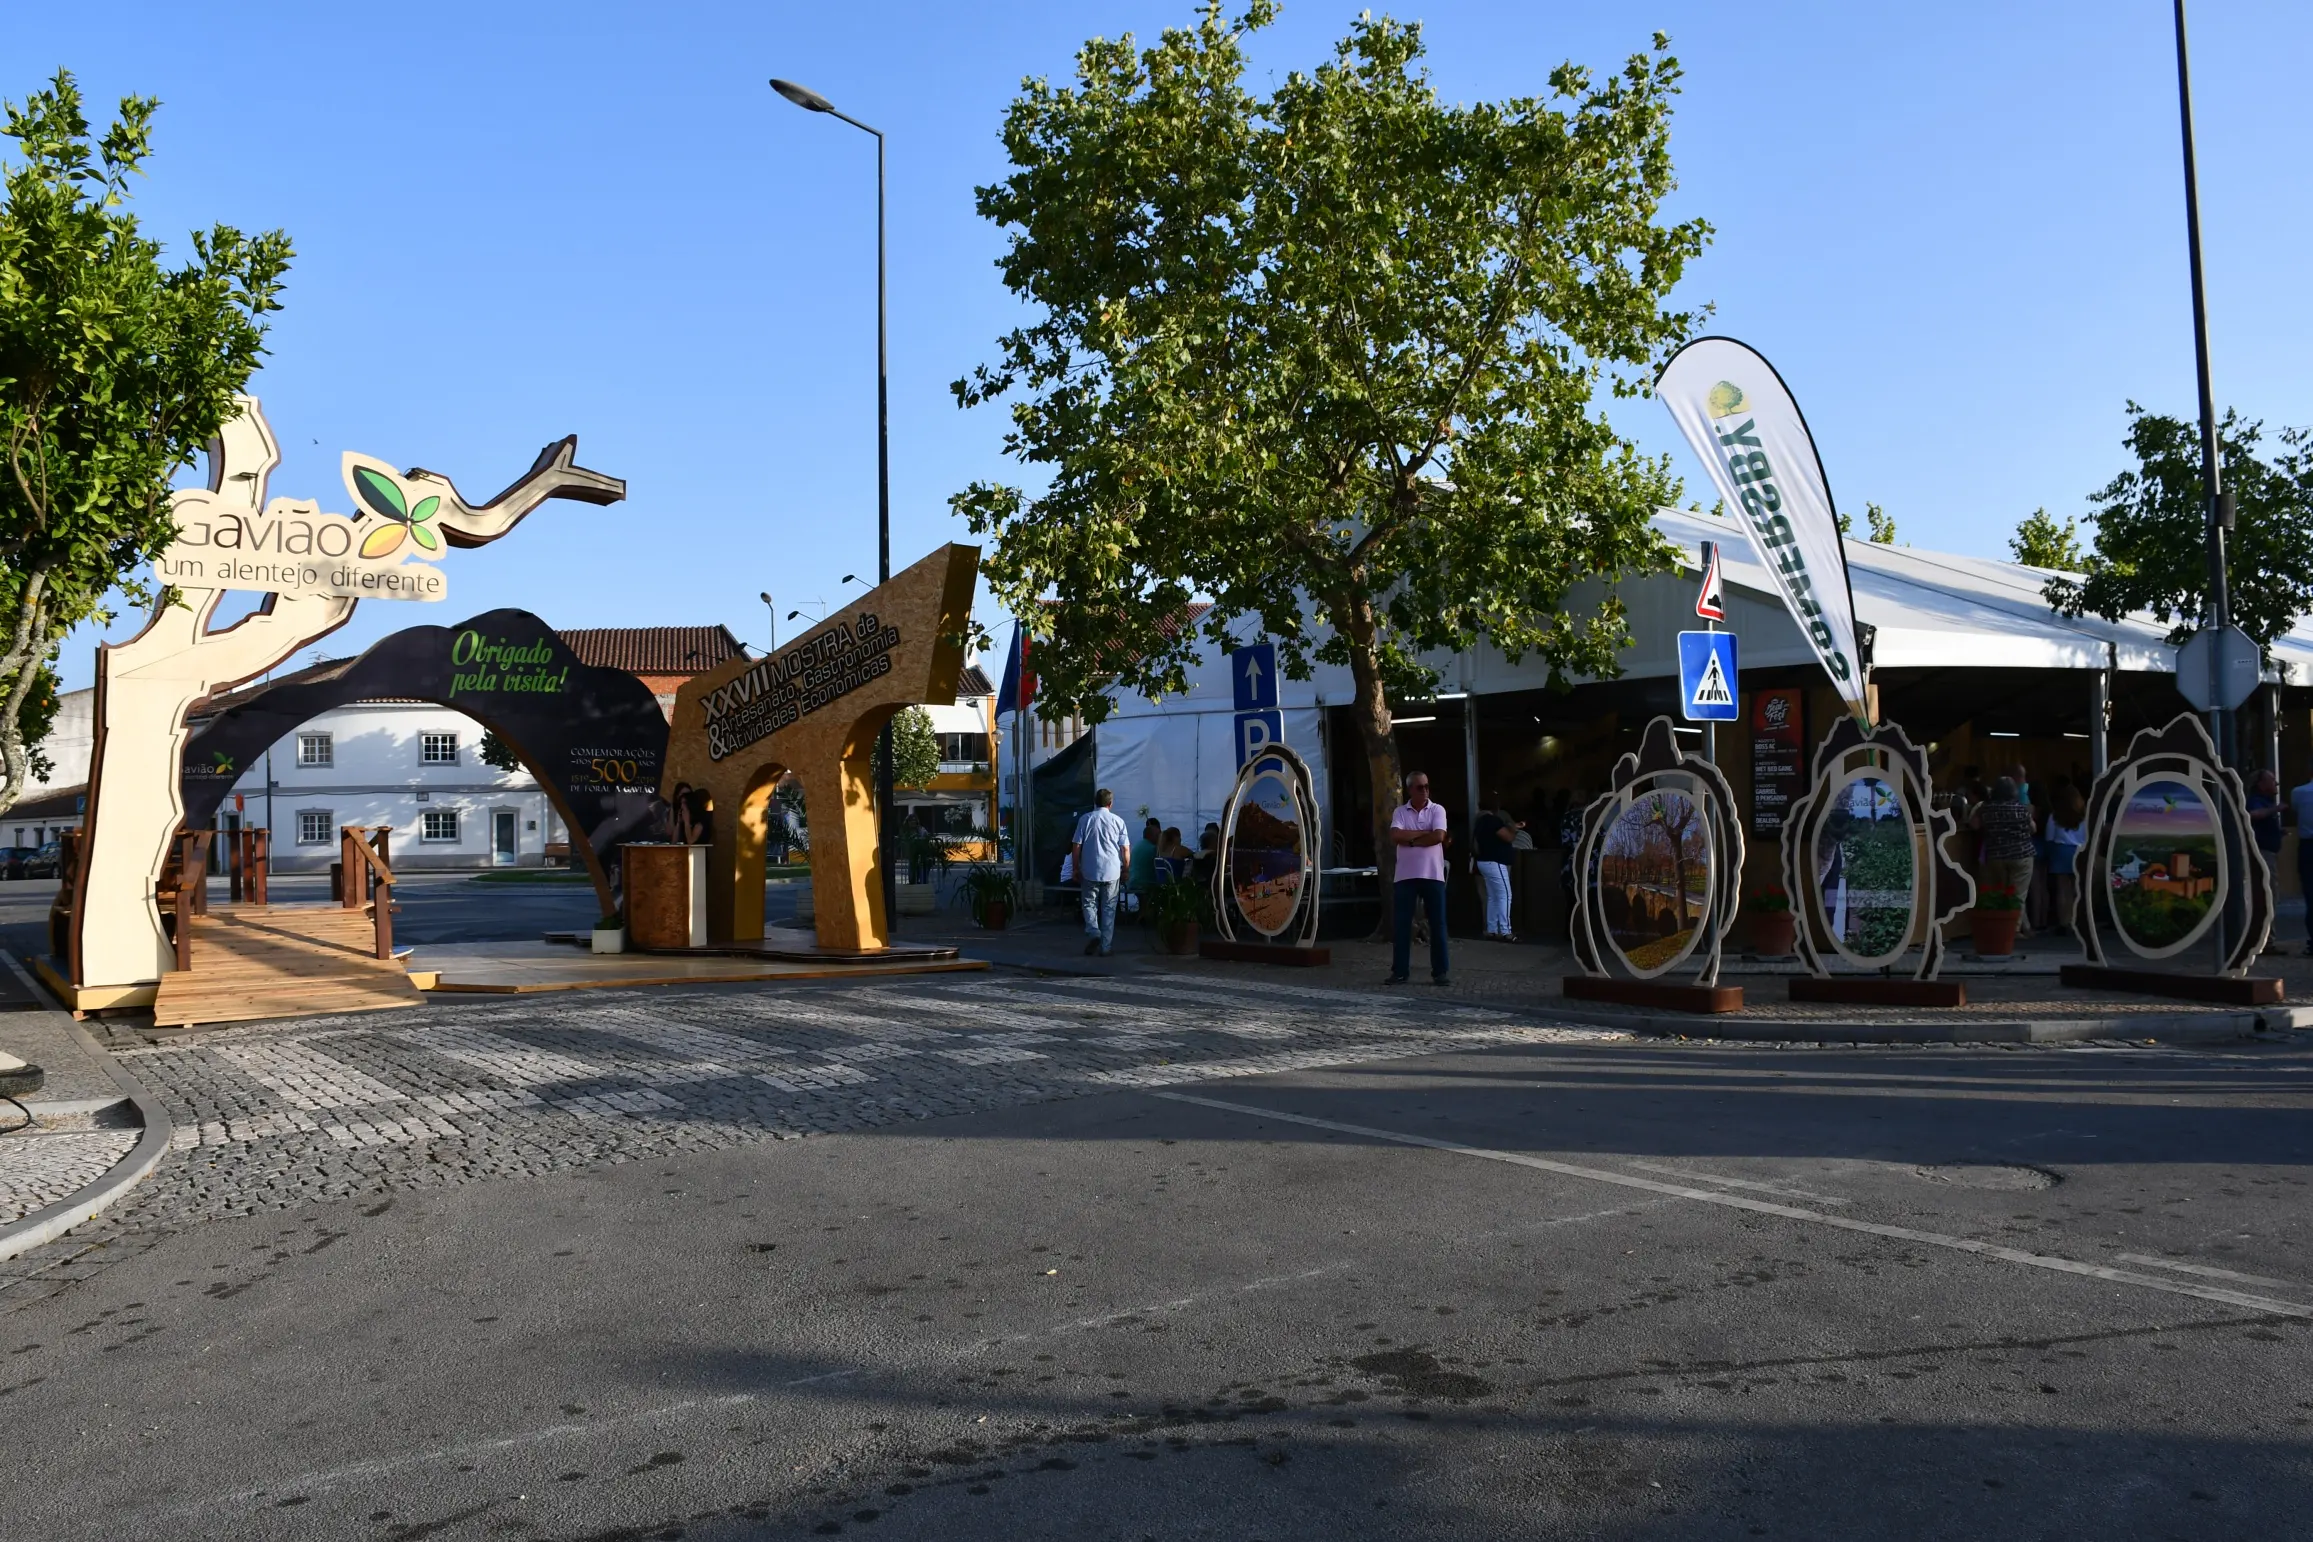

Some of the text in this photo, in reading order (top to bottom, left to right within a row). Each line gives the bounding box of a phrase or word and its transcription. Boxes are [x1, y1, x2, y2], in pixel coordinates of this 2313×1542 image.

[171, 497, 352, 558] Gavião
[163, 557, 440, 593] um alentejo diferente
[451, 629, 553, 671] Obrigado
[700, 614, 877, 725] XXVII MOSTRA de
[448, 663, 569, 699] pela visita!
[721, 626, 898, 736] Artesanato, Gastronomia
[707, 656, 889, 760] & Atividades Económicas
[570, 747, 655, 759] COMEMORAÇÕES
[1243, 718, 1271, 763] P
[184, 763, 215, 775] avião
[589, 758, 638, 783] 500
[570, 784, 580, 793] DE
[584, 784, 610, 793] FORAL
[623, 784, 655, 794] GAVIÃO
